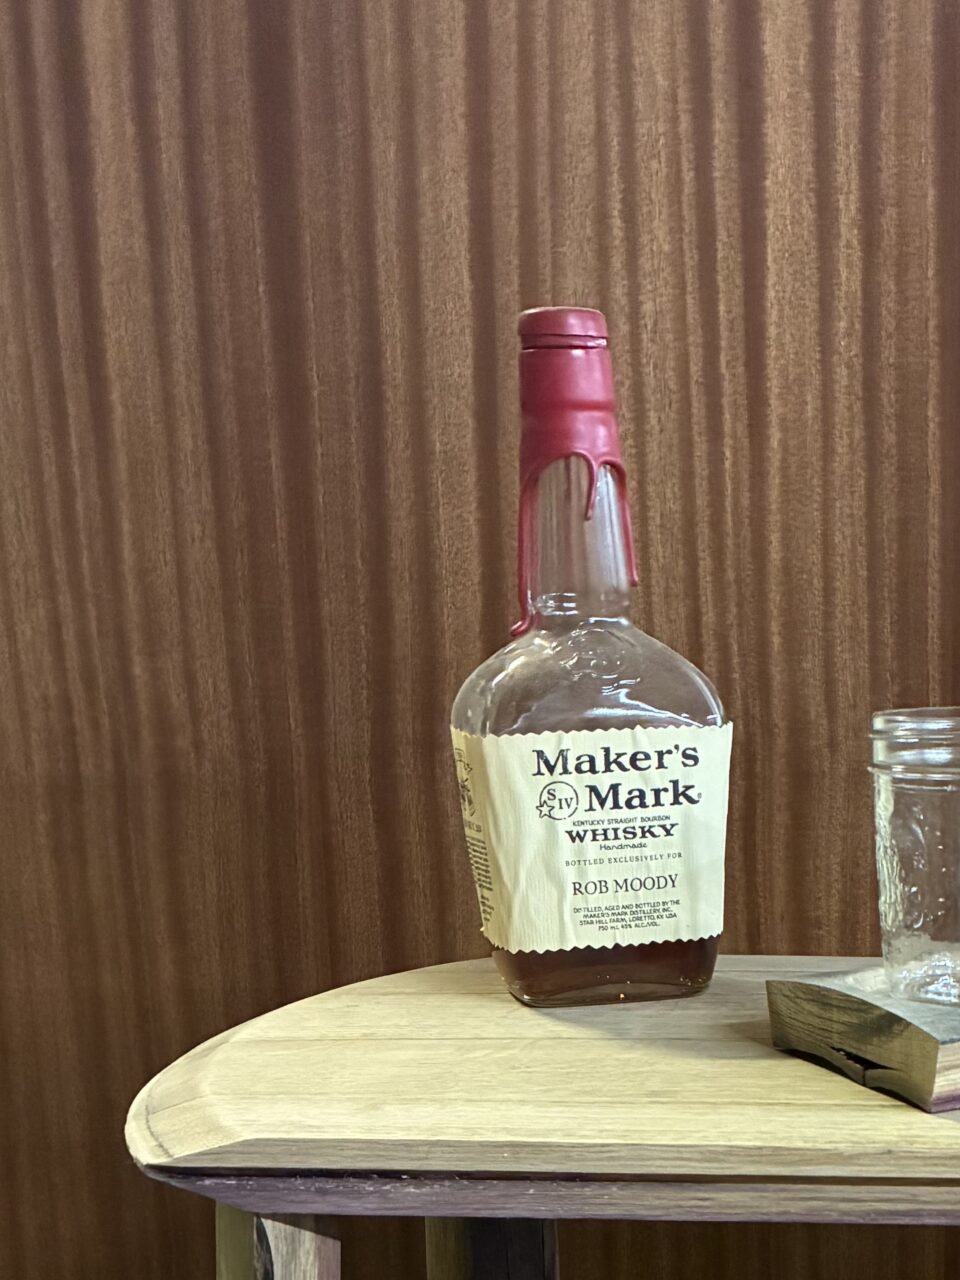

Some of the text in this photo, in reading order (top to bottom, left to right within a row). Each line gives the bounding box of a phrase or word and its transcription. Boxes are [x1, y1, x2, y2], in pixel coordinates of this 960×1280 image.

[532, 744, 699, 776] Maker's
[584, 779, 700, 812] Mark
[607, 817, 638, 825] STRAIGHT
[640, 815, 671, 823] BOURBON
[565, 823, 679, 844] WHISKY
[599, 842, 648, 851] Handmade
[565, 859, 604, 867] BOTTLED
[608, 855, 664, 864] EXCLUSIVELY
[572, 874, 678, 895] ROB MOODY
